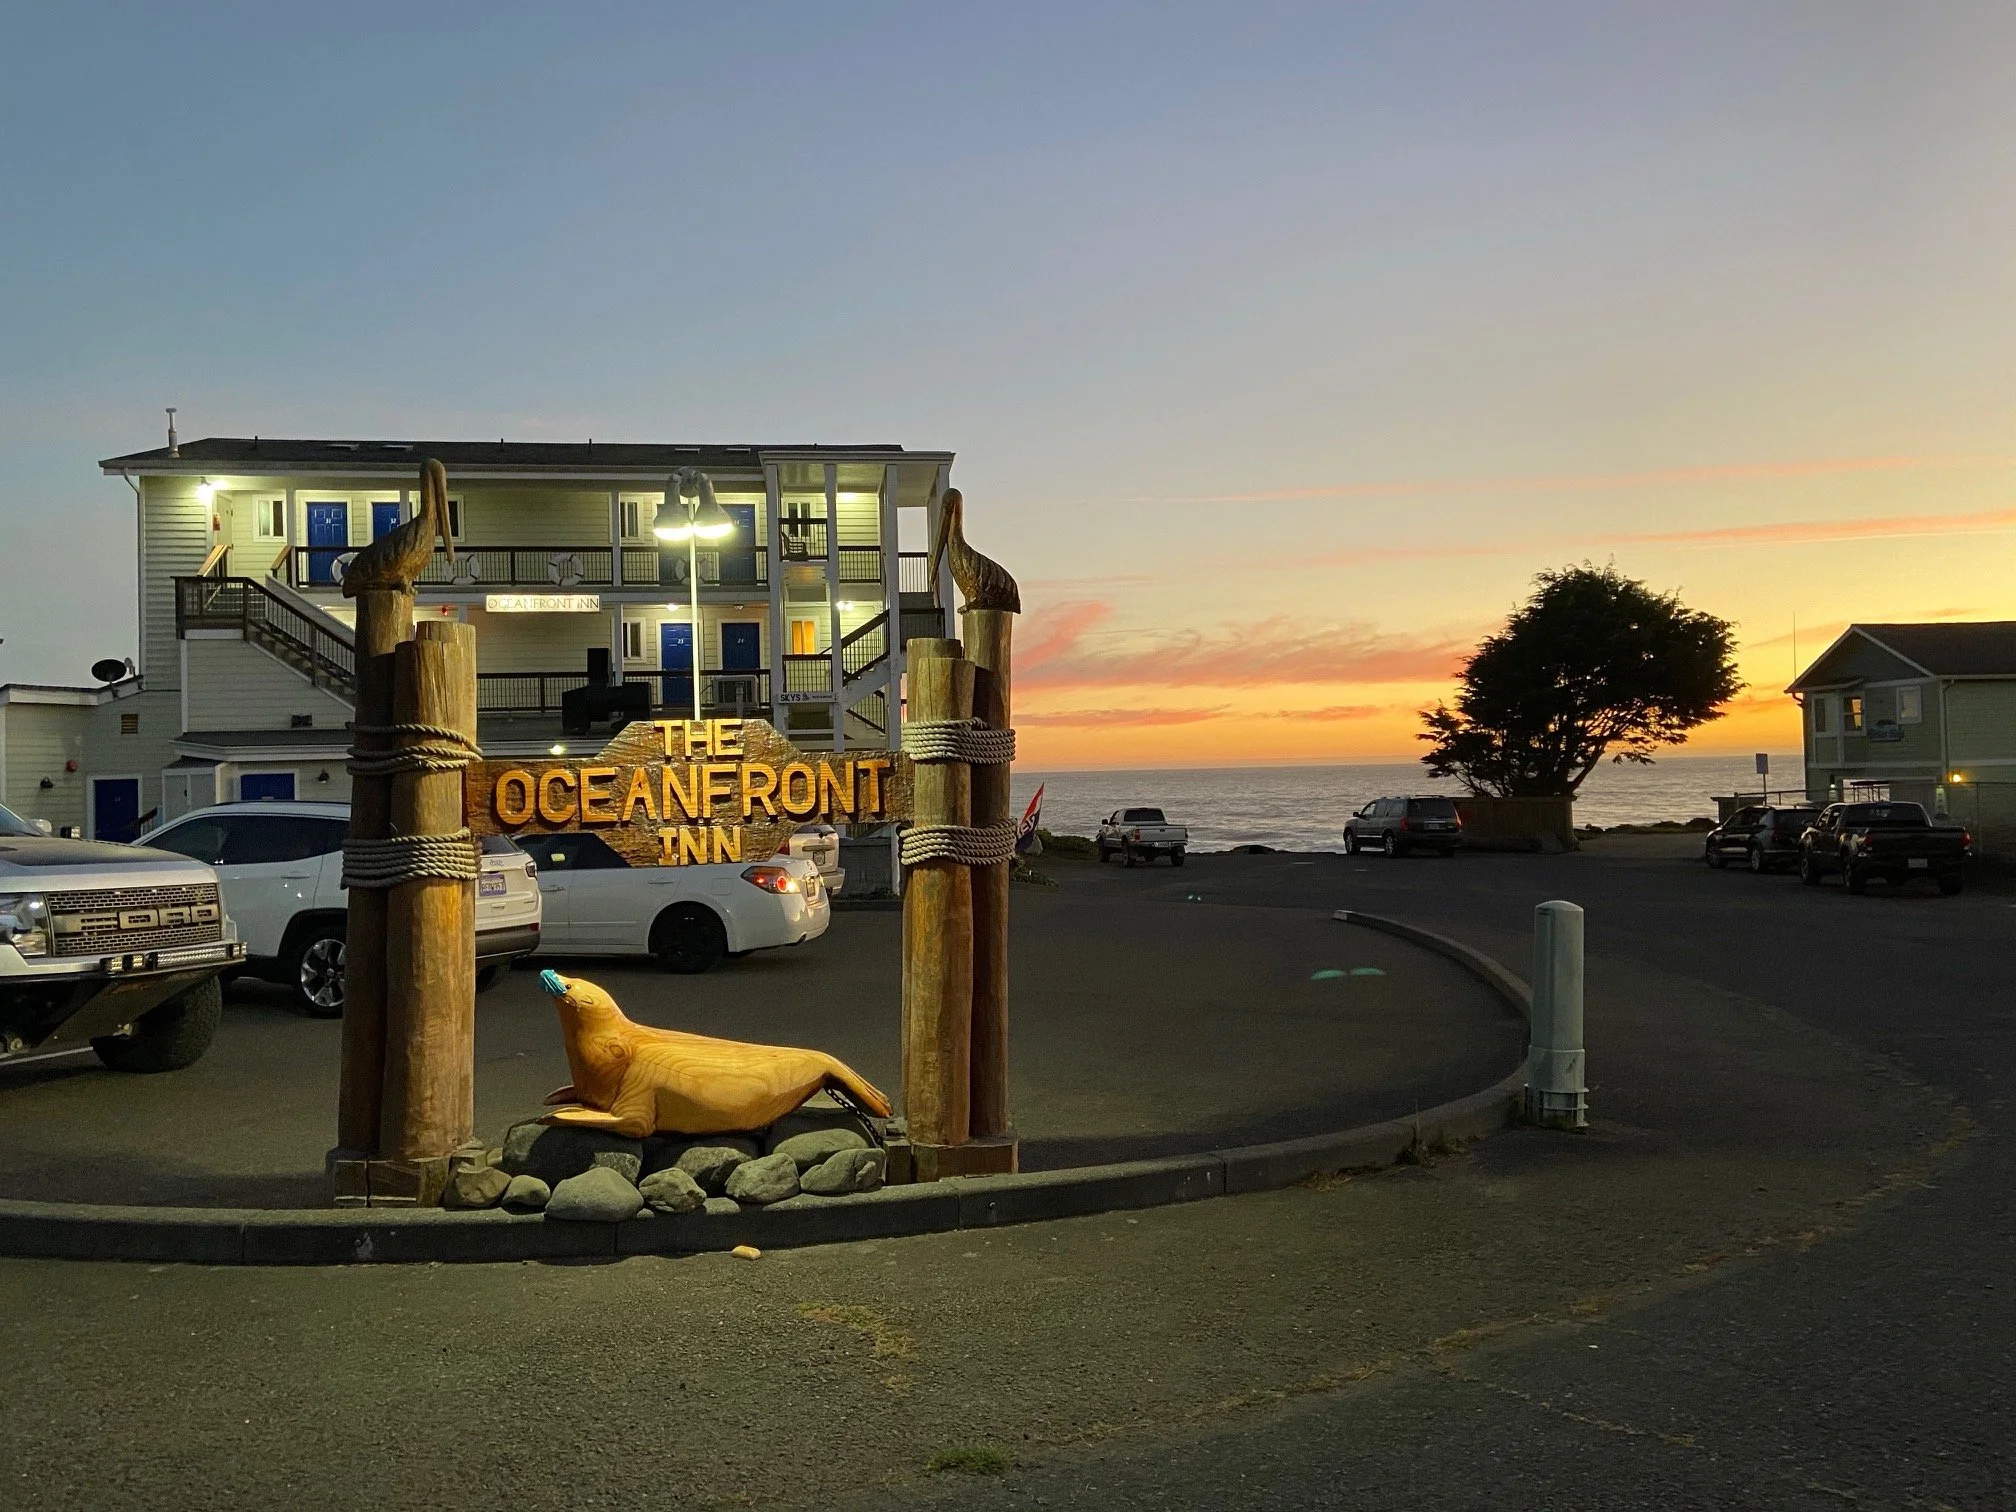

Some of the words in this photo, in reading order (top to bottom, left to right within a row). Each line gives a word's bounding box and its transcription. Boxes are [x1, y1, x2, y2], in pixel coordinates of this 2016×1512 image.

[577, 598, 599, 609] INN
[780, 693, 801, 702] SKYS
[654, 718, 744, 757] THE
[495, 758, 891, 826] OCEANFRONT
[657, 825, 743, 867] INN
[53, 903, 220, 934] FORD
